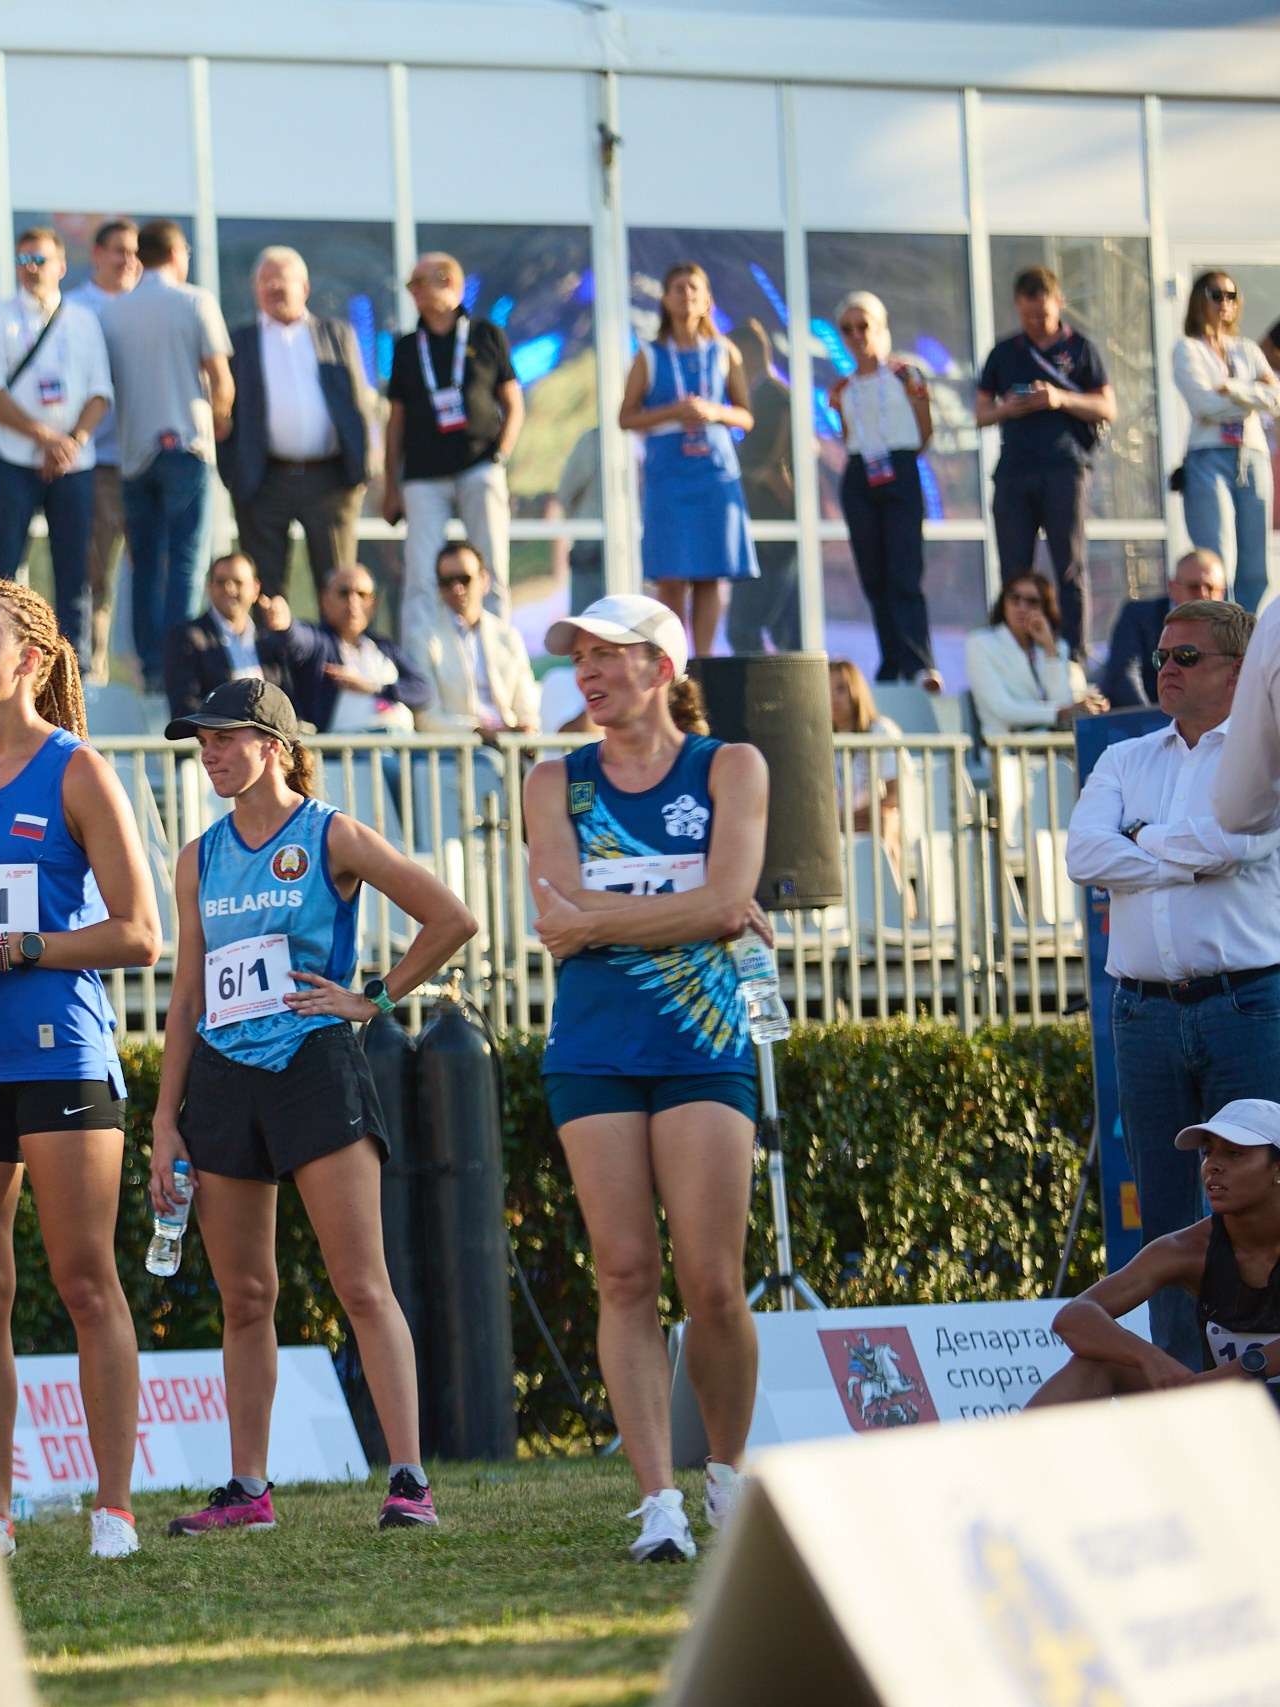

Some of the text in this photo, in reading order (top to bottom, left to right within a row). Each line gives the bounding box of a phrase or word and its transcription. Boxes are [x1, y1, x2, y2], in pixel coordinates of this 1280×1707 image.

[205, 889, 303, 918] BELARUS
[218, 957, 269, 1001] 6/1
[935, 1326, 1065, 1357] Департам
[946, 1364, 1042, 1393] спорта
[23, 1377, 227, 1428] МООВСК
[959, 1402, 1022, 1424] горо
[39, 1433, 155, 1481] СПТ
